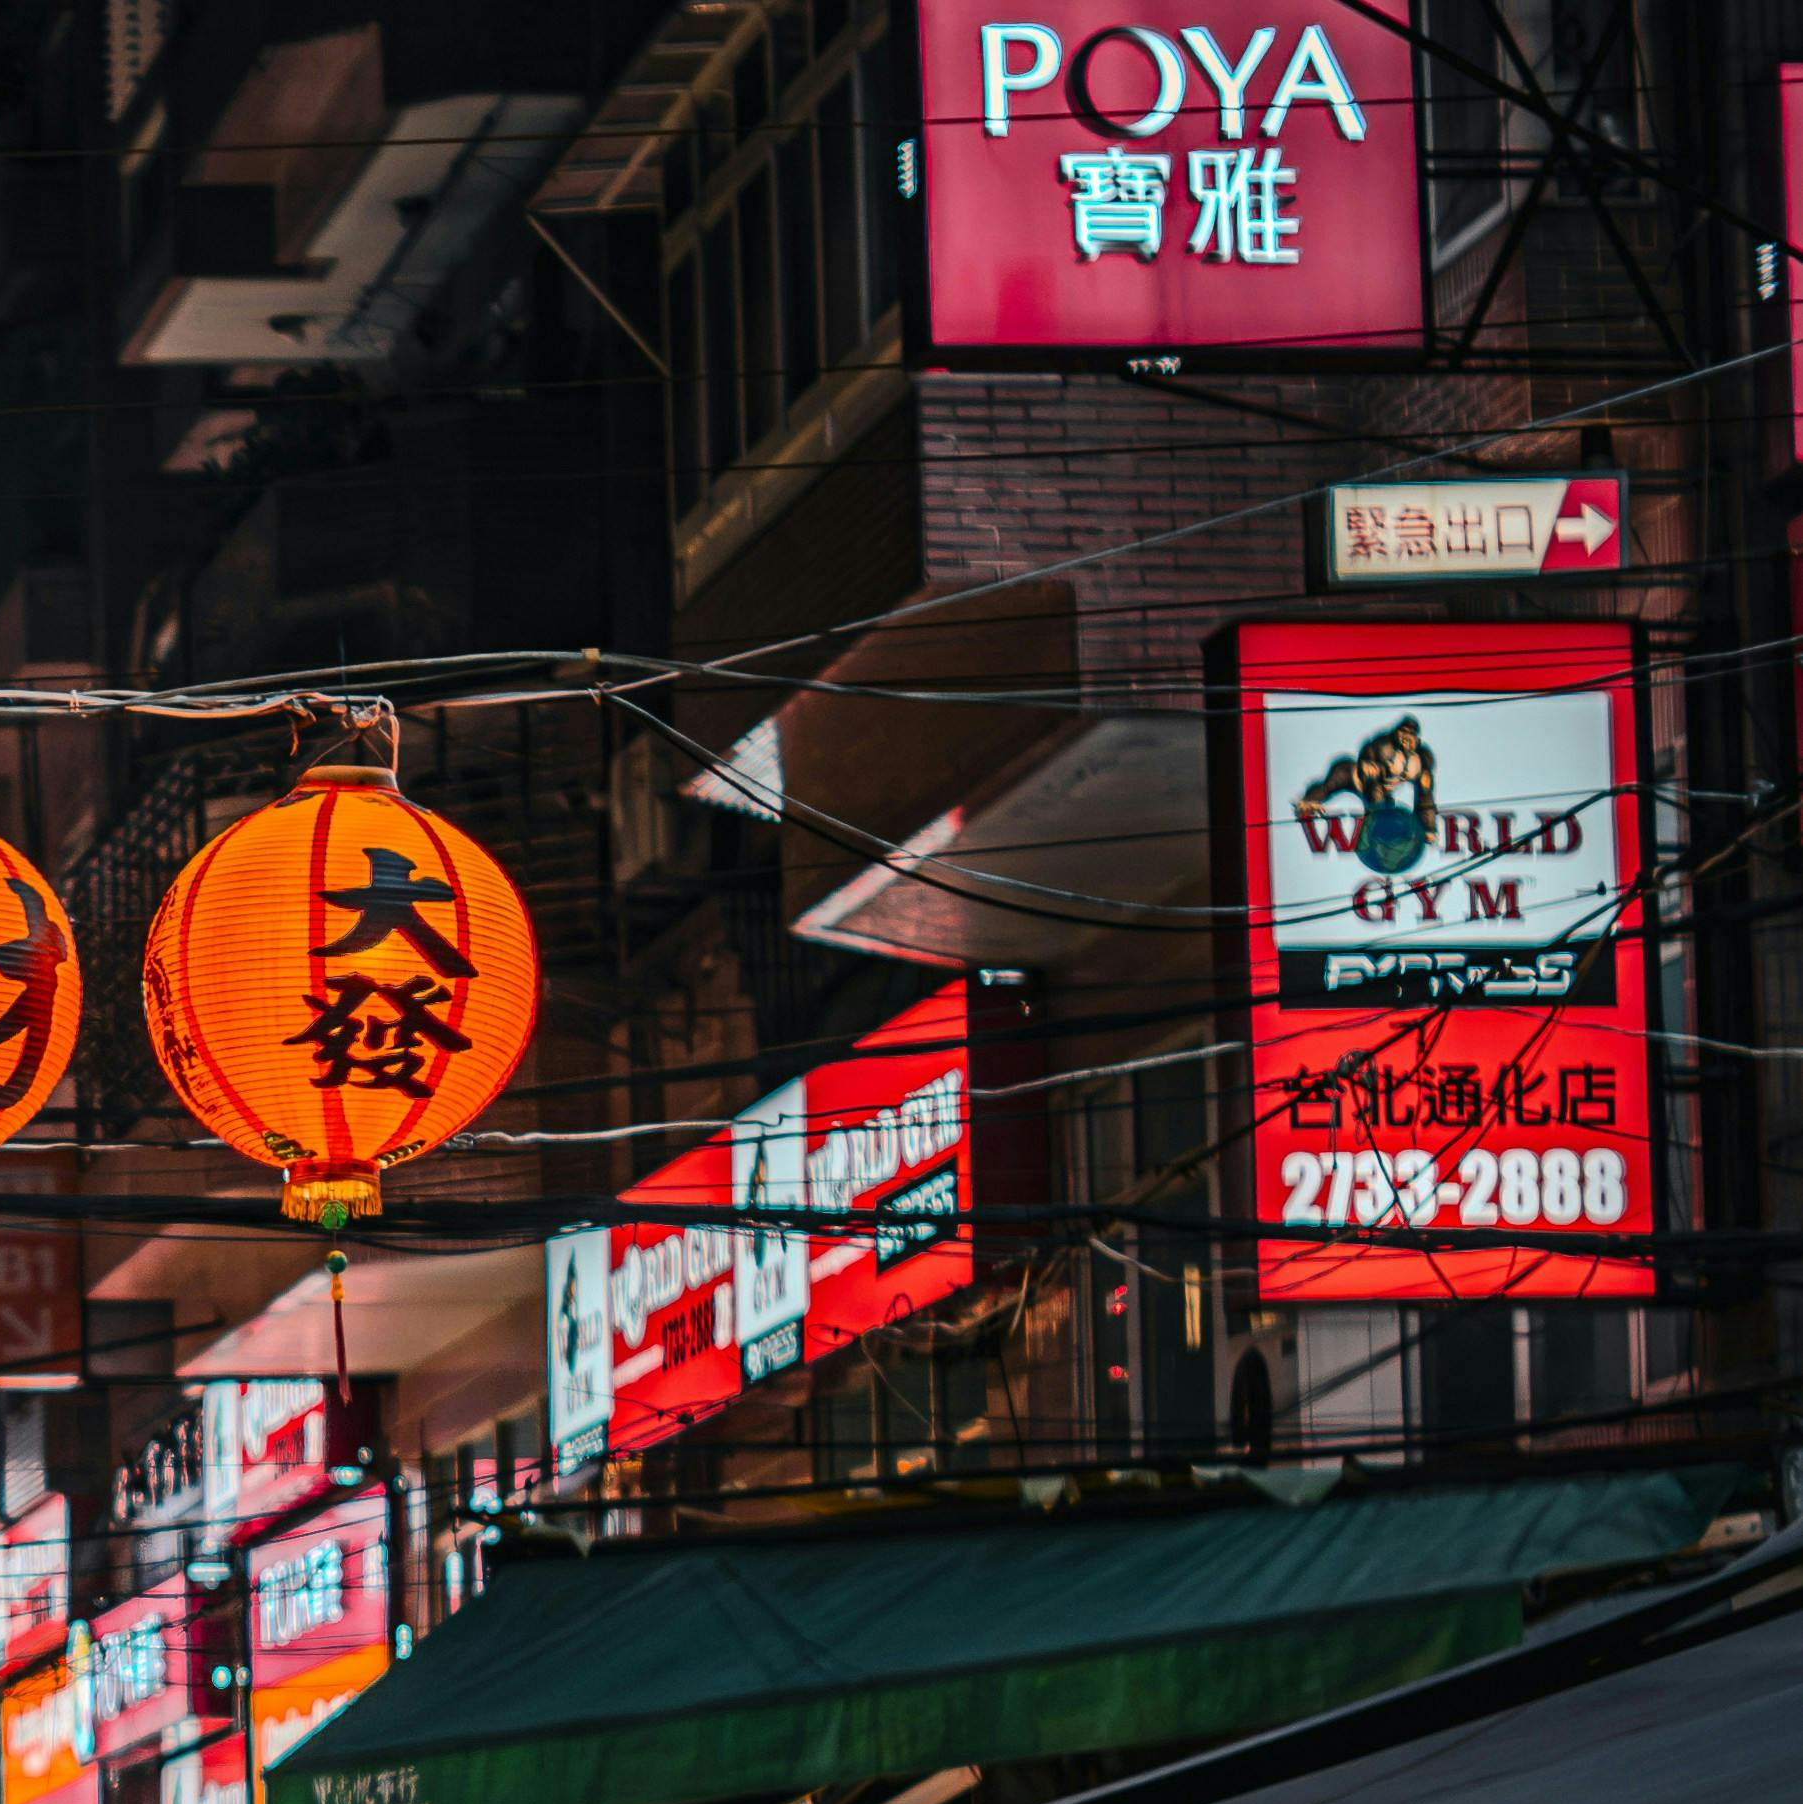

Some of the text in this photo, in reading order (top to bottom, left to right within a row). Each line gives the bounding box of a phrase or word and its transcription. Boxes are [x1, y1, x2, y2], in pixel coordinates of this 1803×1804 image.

[980, 21, 1366, 141] POYA
[1060, 146, 1301, 265] 寶雅
[1345, 500, 1537, 562] 緊急出口
[1351, 877, 1524, 923] GYM
[282, 846, 479, 1100] 大發
[1285, 1066, 1617, 1131] 台北通化店
[1282, 1147, 1628, 1228] 2733-2888
